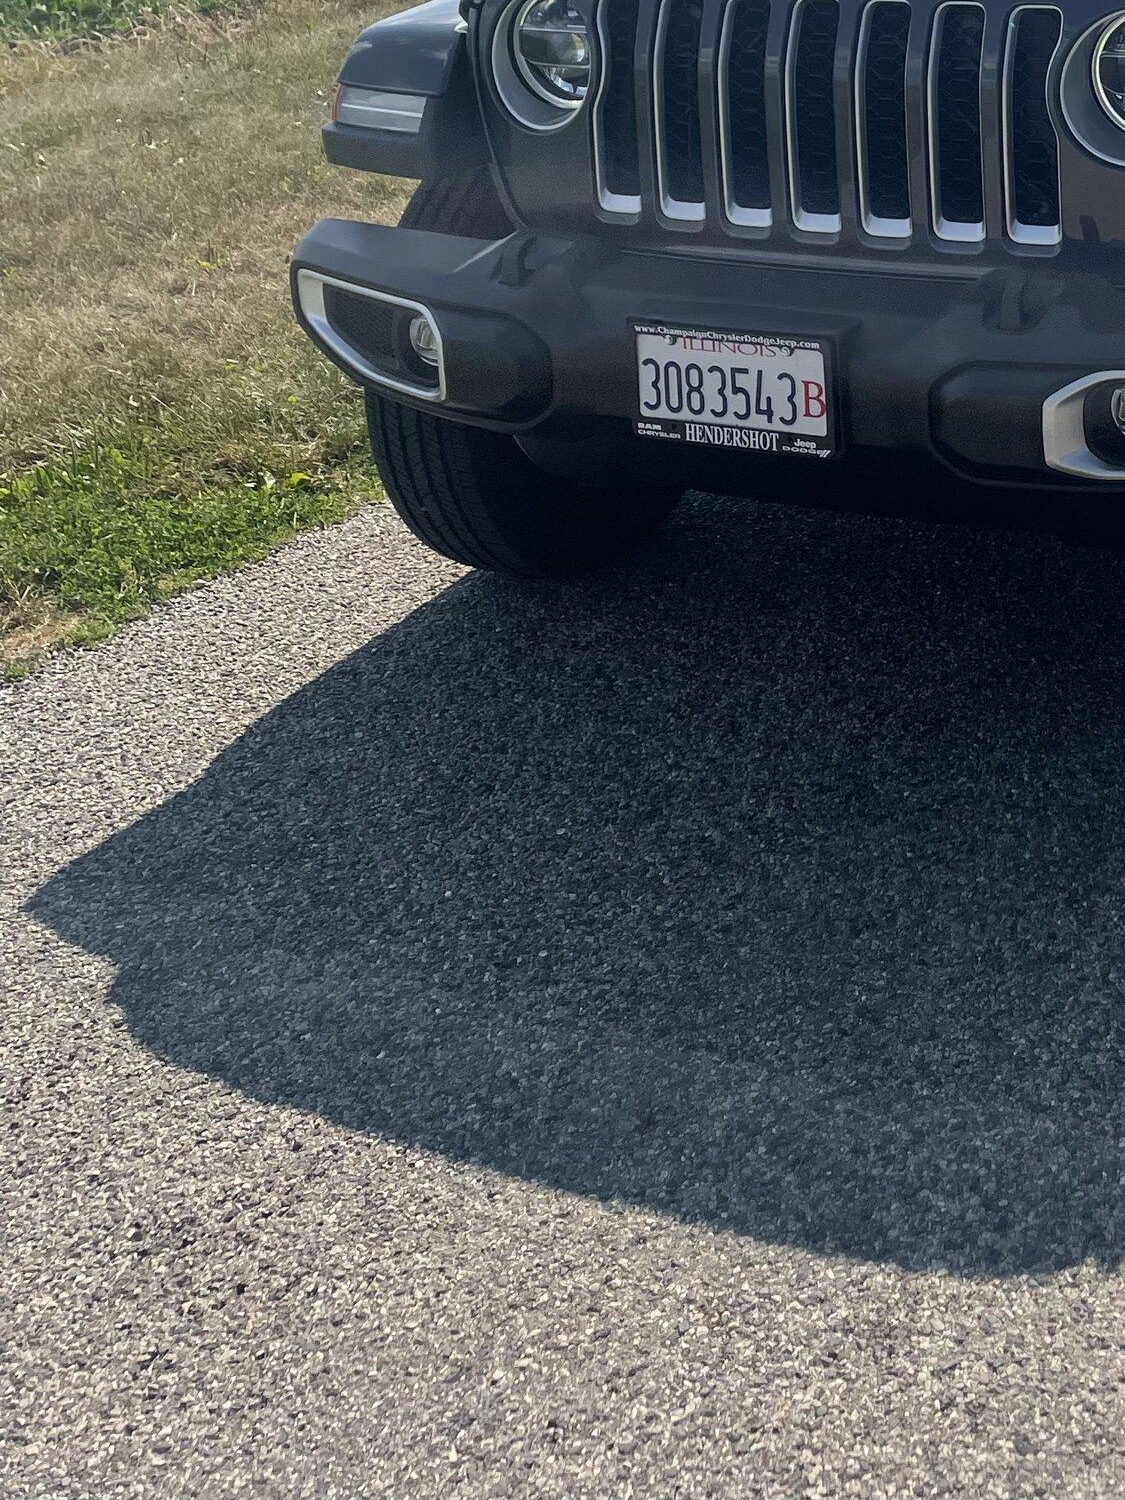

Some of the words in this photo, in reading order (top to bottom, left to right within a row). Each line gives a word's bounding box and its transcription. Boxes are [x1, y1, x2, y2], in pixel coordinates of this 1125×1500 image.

[634, 325, 820, 350] www.ChampaignChryslerDodgeJeep.com
[682, 337, 777, 358] ILLINOIS
[641, 357, 827, 426] 3083543B
[637, 429, 681, 440] CHRYSLER
[638, 422, 662, 431] RAM
[684, 422, 779, 452] HENDERSHOT
[794, 438, 817, 450] Jeep
[782, 445, 824, 456] DODGE
